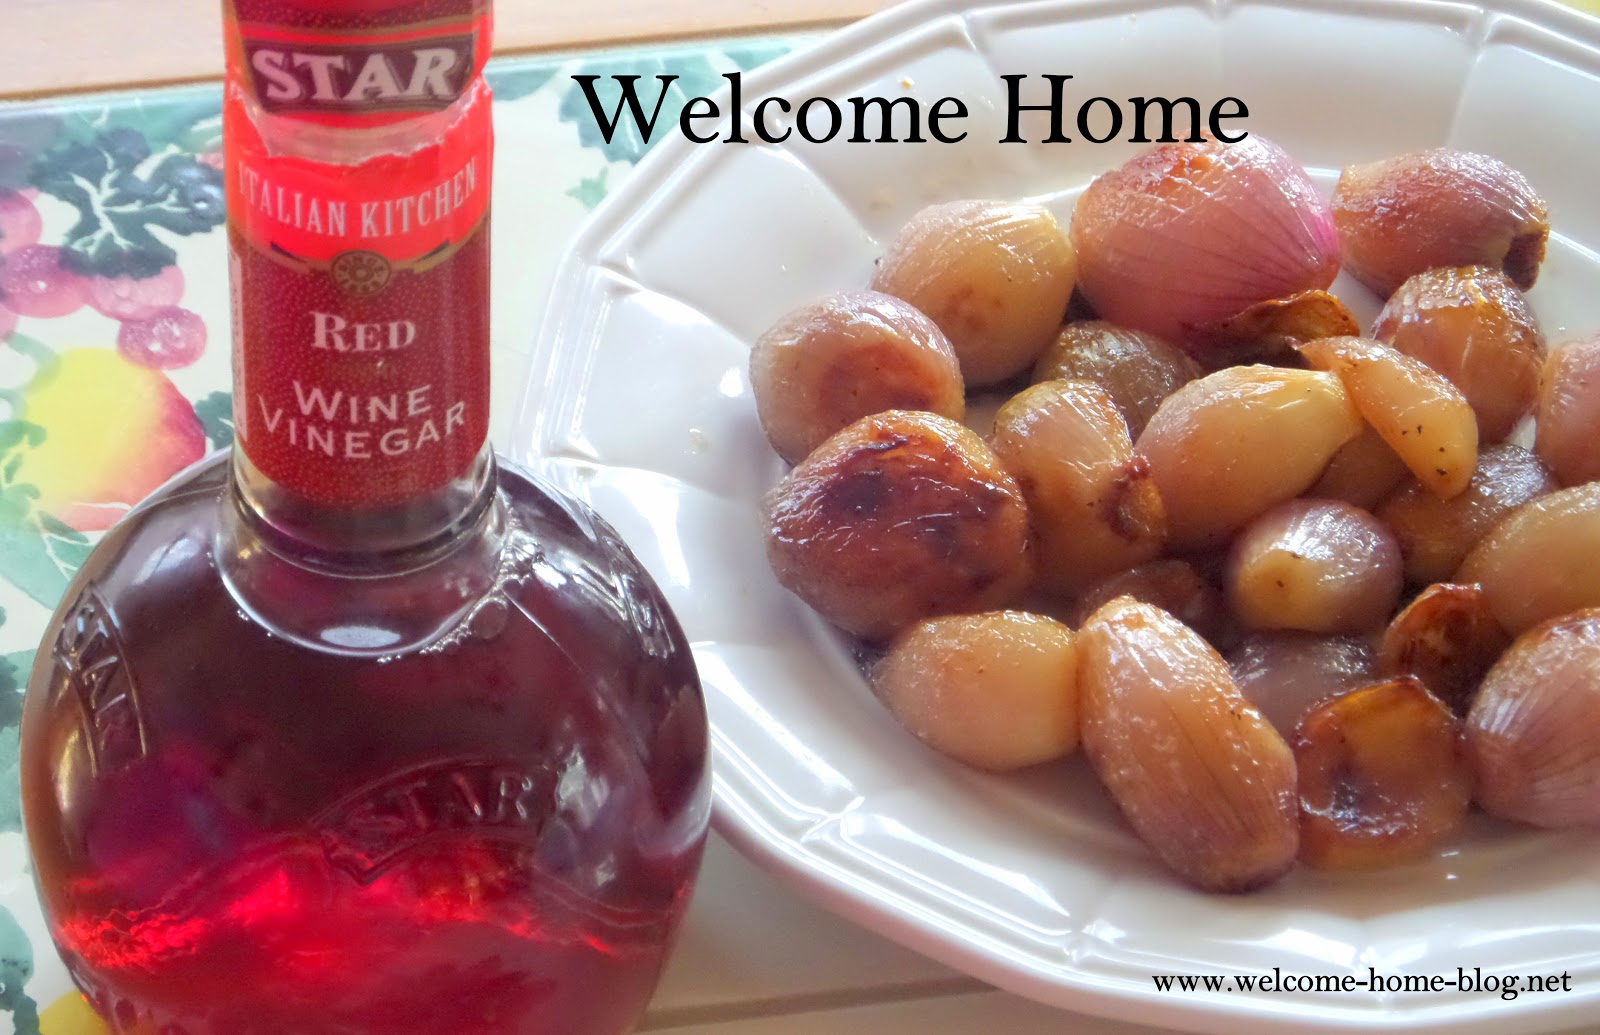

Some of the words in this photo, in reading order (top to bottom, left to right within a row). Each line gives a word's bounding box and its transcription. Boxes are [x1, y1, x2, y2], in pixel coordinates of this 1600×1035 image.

[252, 48, 456, 101] STAR
[238, 160, 346, 238] ITALIAN
[360, 157, 476, 238] KITCHEN
[257, 393, 466, 459] VINEGAR
[292, 380, 432, 423] WINE
